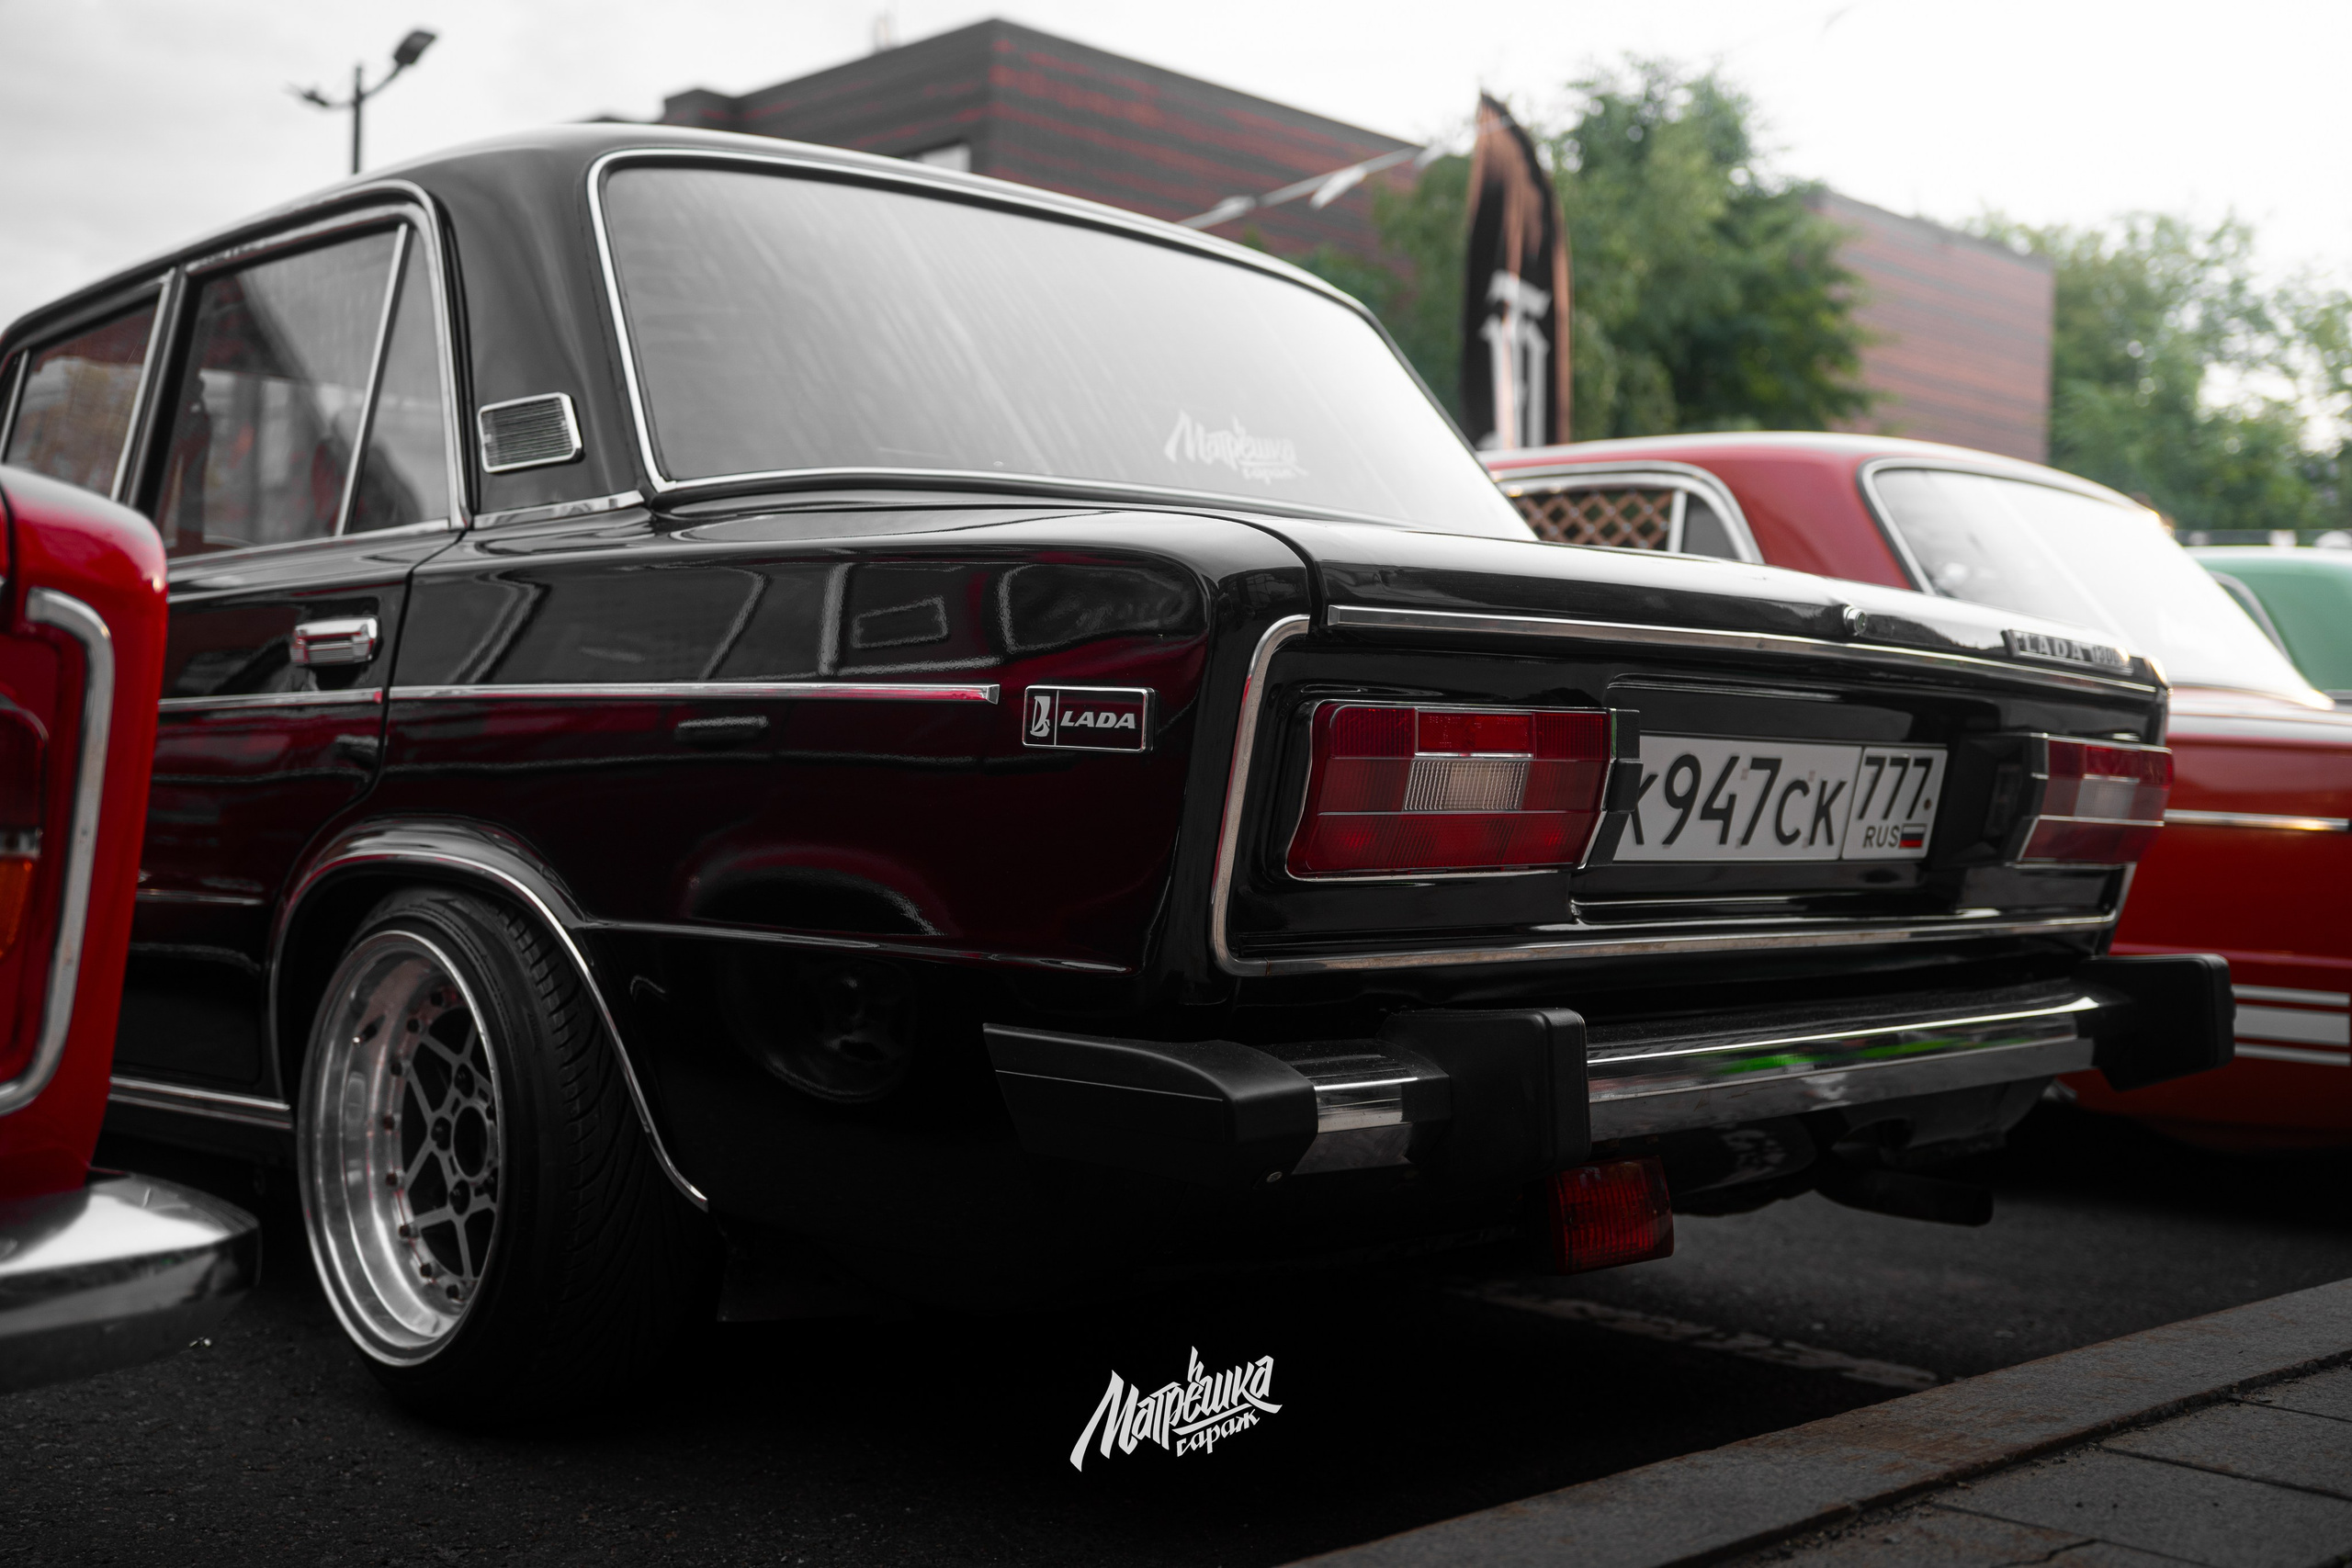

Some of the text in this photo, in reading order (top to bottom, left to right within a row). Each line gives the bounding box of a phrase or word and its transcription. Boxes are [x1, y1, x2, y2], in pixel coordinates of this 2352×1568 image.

[2023, 634, 2084, 660] LADA
[1060, 710, 1136, 728] LADA
[1858, 756, 1933, 820] 777
[1862, 826, 1898, 849] RUS
